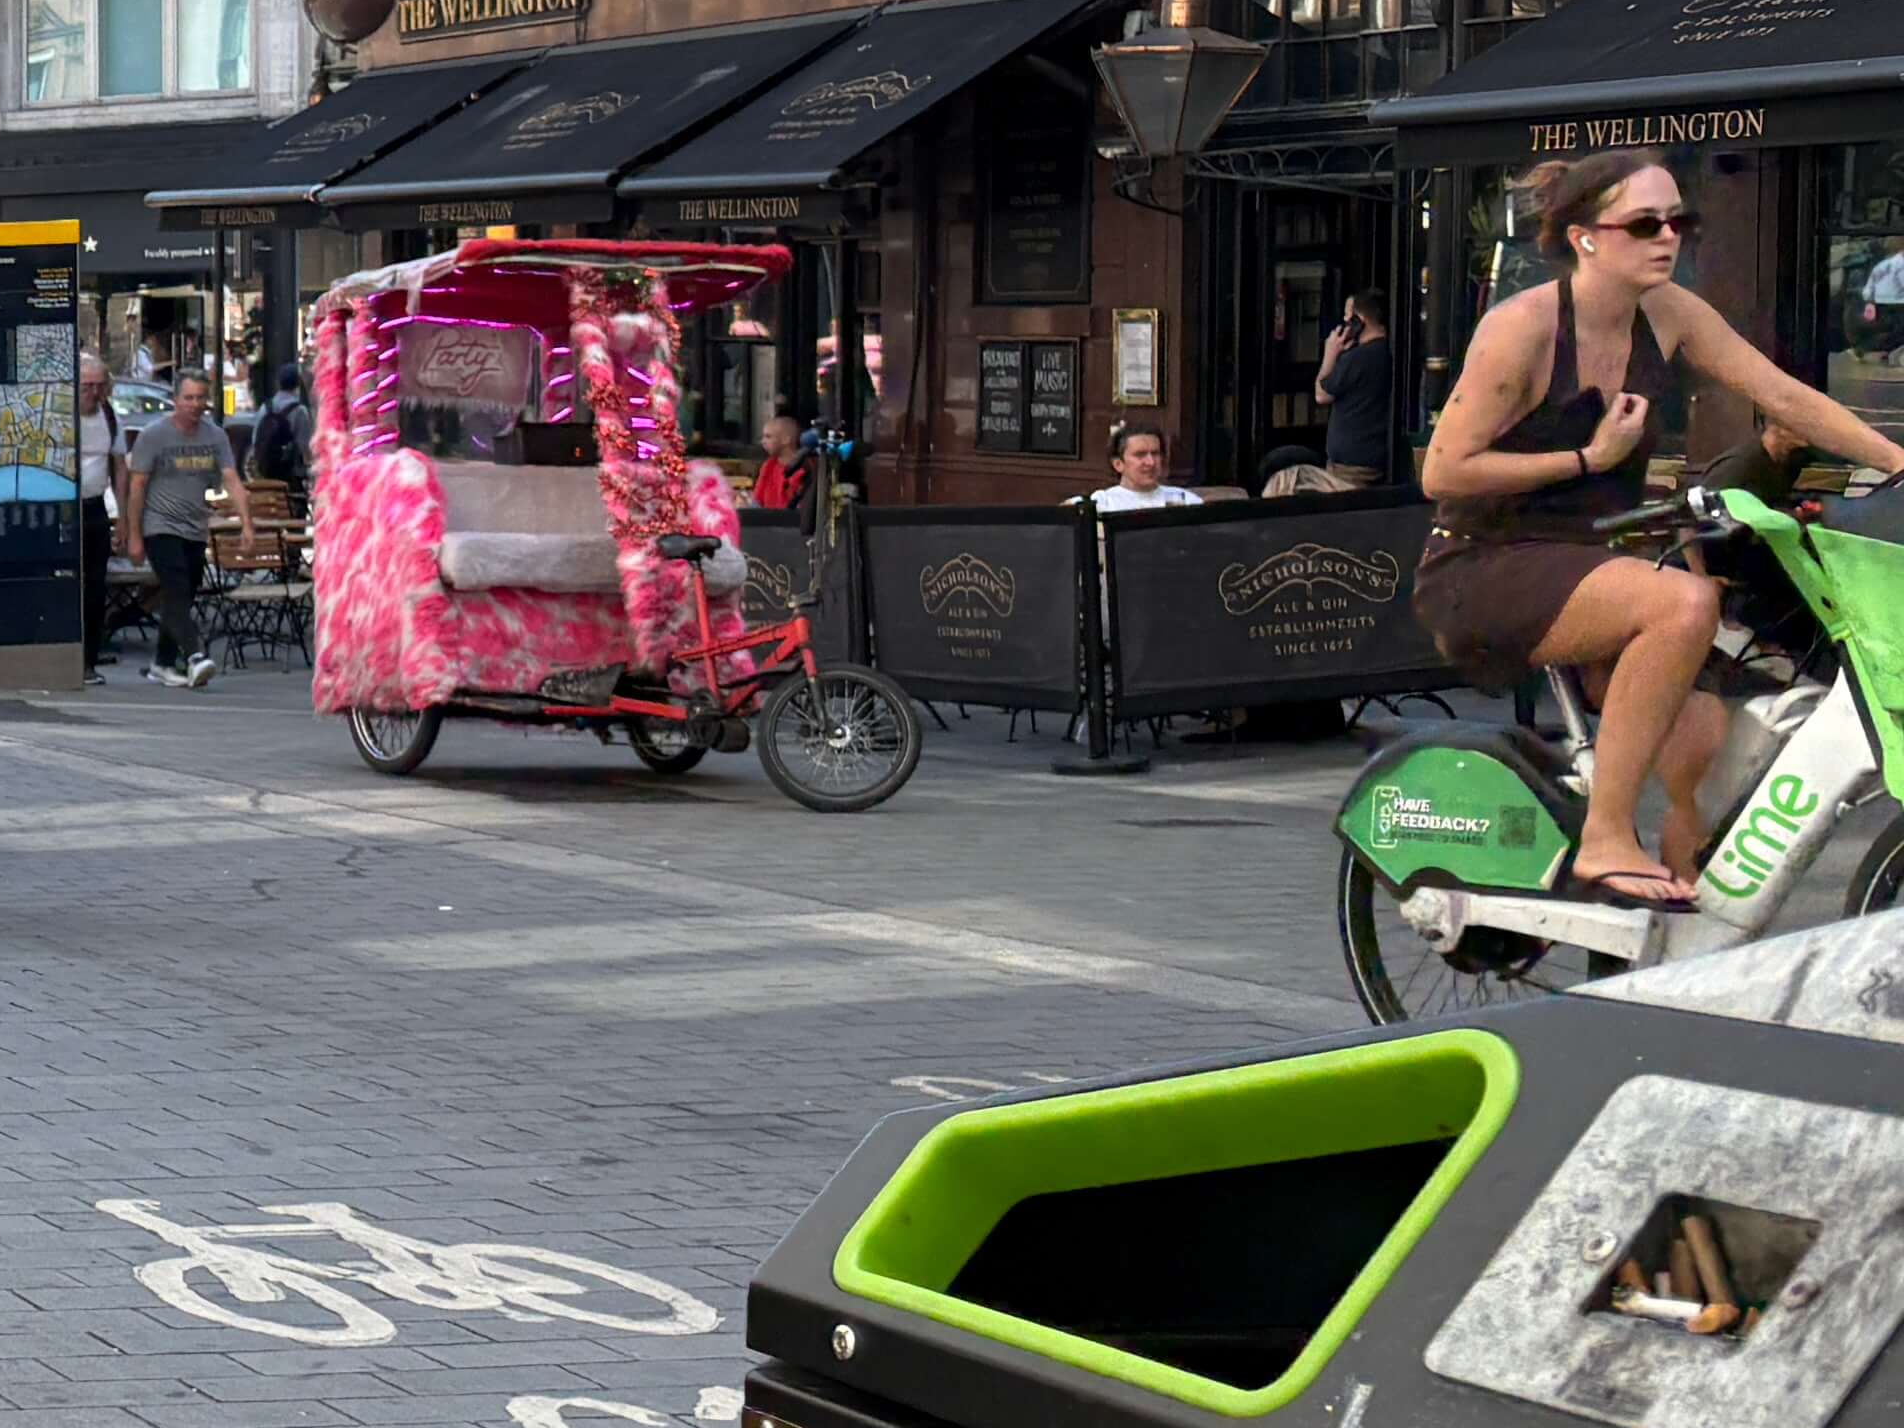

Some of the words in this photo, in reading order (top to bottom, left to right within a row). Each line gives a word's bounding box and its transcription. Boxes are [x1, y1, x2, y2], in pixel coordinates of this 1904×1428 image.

[1529, 121, 1579, 151] THE
[1584, 108, 1766, 148] WELLINGTON
[679, 200, 703, 220] THE
[706, 197, 800, 219] WELLINGTON
[927, 568, 1010, 604] NICHOLSON'S
[1239, 558, 1382, 600] NICHOLSON'S
[1274, 603, 1299, 614] ALE
[1248, 616, 1376, 639] ESTABLISHMENTS
[1274, 641, 1317, 656] SINCE
[1393, 797, 1431, 813] HAVE
[1392, 812, 1490, 832] FEEDBACK?
